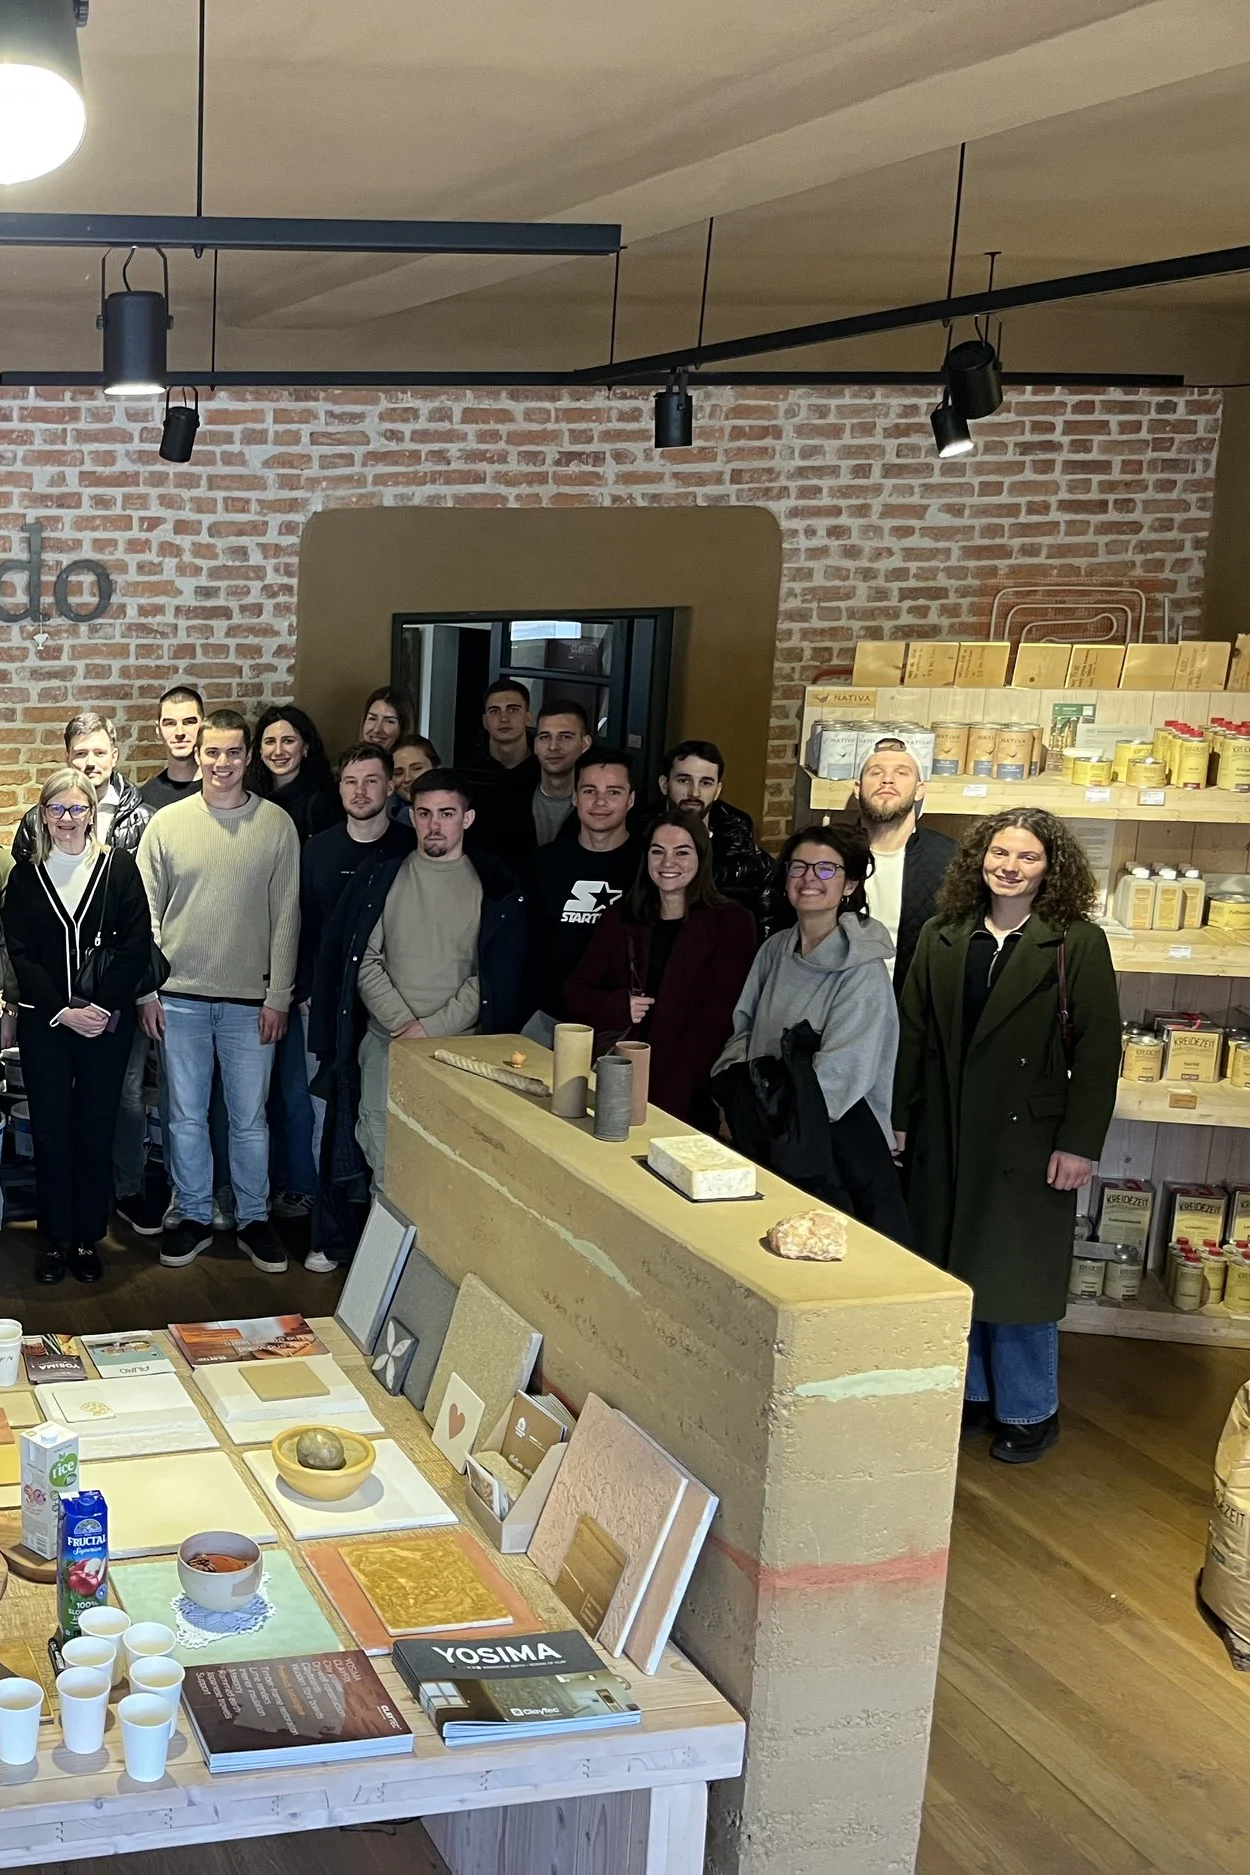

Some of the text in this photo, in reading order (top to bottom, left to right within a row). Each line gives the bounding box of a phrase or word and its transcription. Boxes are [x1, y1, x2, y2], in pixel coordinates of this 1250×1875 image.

[833, 694, 871, 702] NATIVA
[560, 912, 601, 924] START
[1173, 1036, 1215, 1049] KREIDEZEIT
[1106, 1194, 1148, 1207] KREIDEZEIT
[1179, 1202, 1222, 1214] KREIDEZEIT
[38, 1361, 81, 1371] YOSIMA
[119, 1365, 150, 1374] AURO
[52, 1460, 75, 1479] rice
[67, 1534, 107, 1547] FRUCTAL
[431, 1642, 563, 1665] YOSIMA
[345, 1658, 362, 1681] YOSIMA
[196, 1673, 212, 1695] Support
[249, 1689, 266, 1717] insulation
[279, 1706, 298, 1736] restoration
[382, 1705, 401, 1729] CLAYTEC
